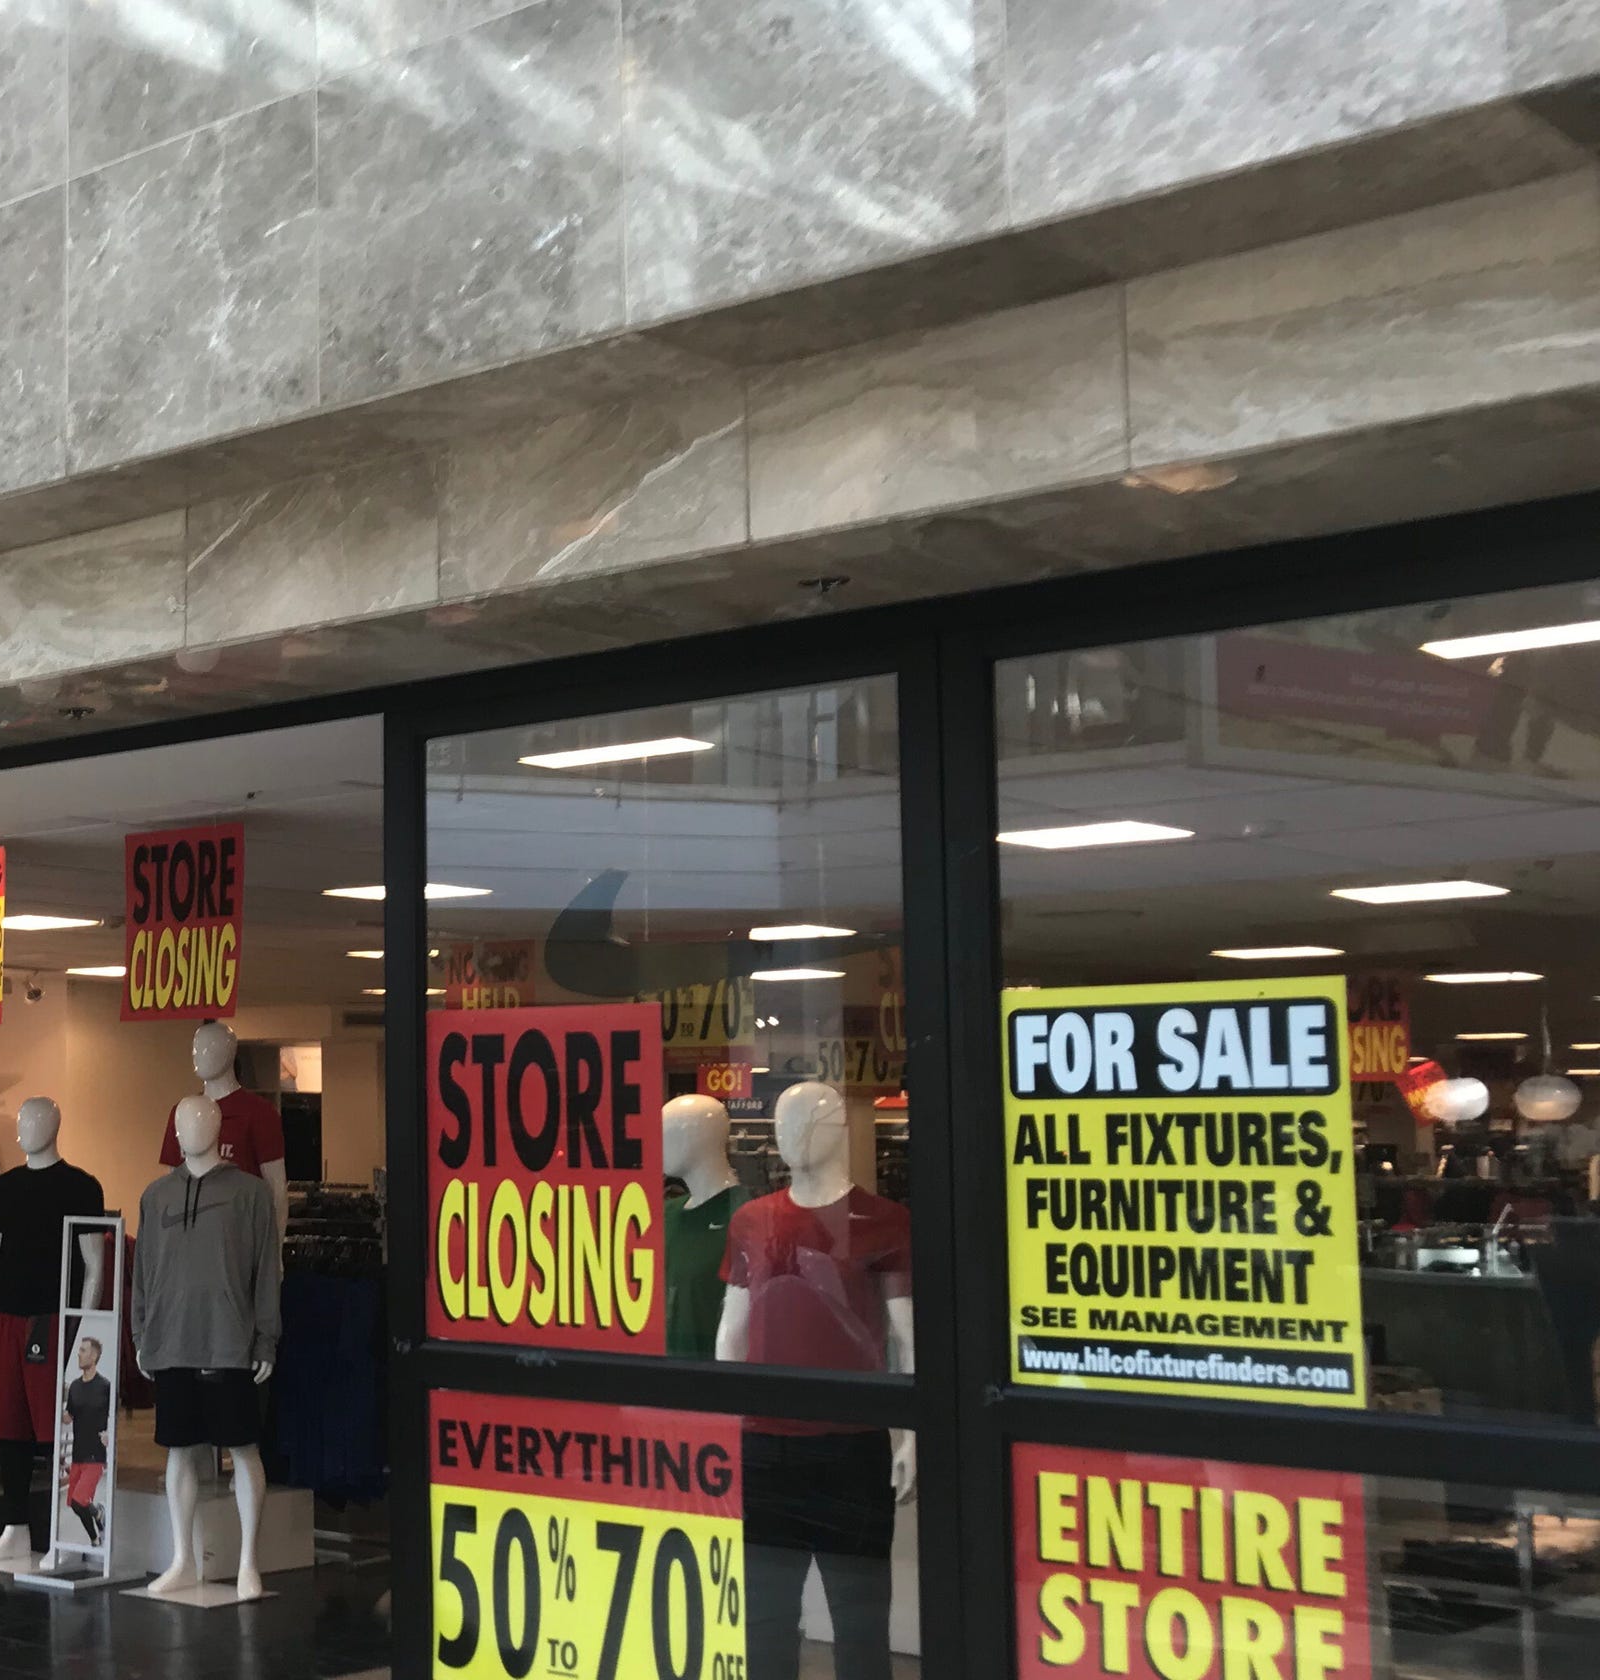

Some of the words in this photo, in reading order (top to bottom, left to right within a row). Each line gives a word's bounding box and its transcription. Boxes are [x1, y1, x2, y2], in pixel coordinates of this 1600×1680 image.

[133, 837, 236, 924] STORE
[130, 922, 237, 1010] CLOSING
[706, 1068, 744, 1091] GO!
[1013, 1009, 1136, 1094] FOR
[1156, 1002, 1331, 1092] SALE
[1350, 1025, 1407, 1074] SING
[437, 1029, 643, 1172] STORE
[1012, 1112, 1091, 1168] ALL
[1105, 1110, 1343, 1174] FIXTURES,
[1025, 1177, 1279, 1236] FURNITURE
[1294, 1180, 1335, 1237] &
[437, 1178, 655, 1335] CLOSING
[1045, 1242, 1315, 1305] EQUIPMENT
[1020, 1305, 1078, 1330] SEE
[1088, 1308, 1349, 1343] MANAGEMENT
[1022, 1341, 1350, 1390] www.hilcofixturefinders.com
[438, 1418, 733, 1498] EVERYTHING
[1037, 1470, 1347, 1597] ENTIRE
[547, 1637, 579, 1671] TO
[1038, 1572, 1346, 1680] STORE
